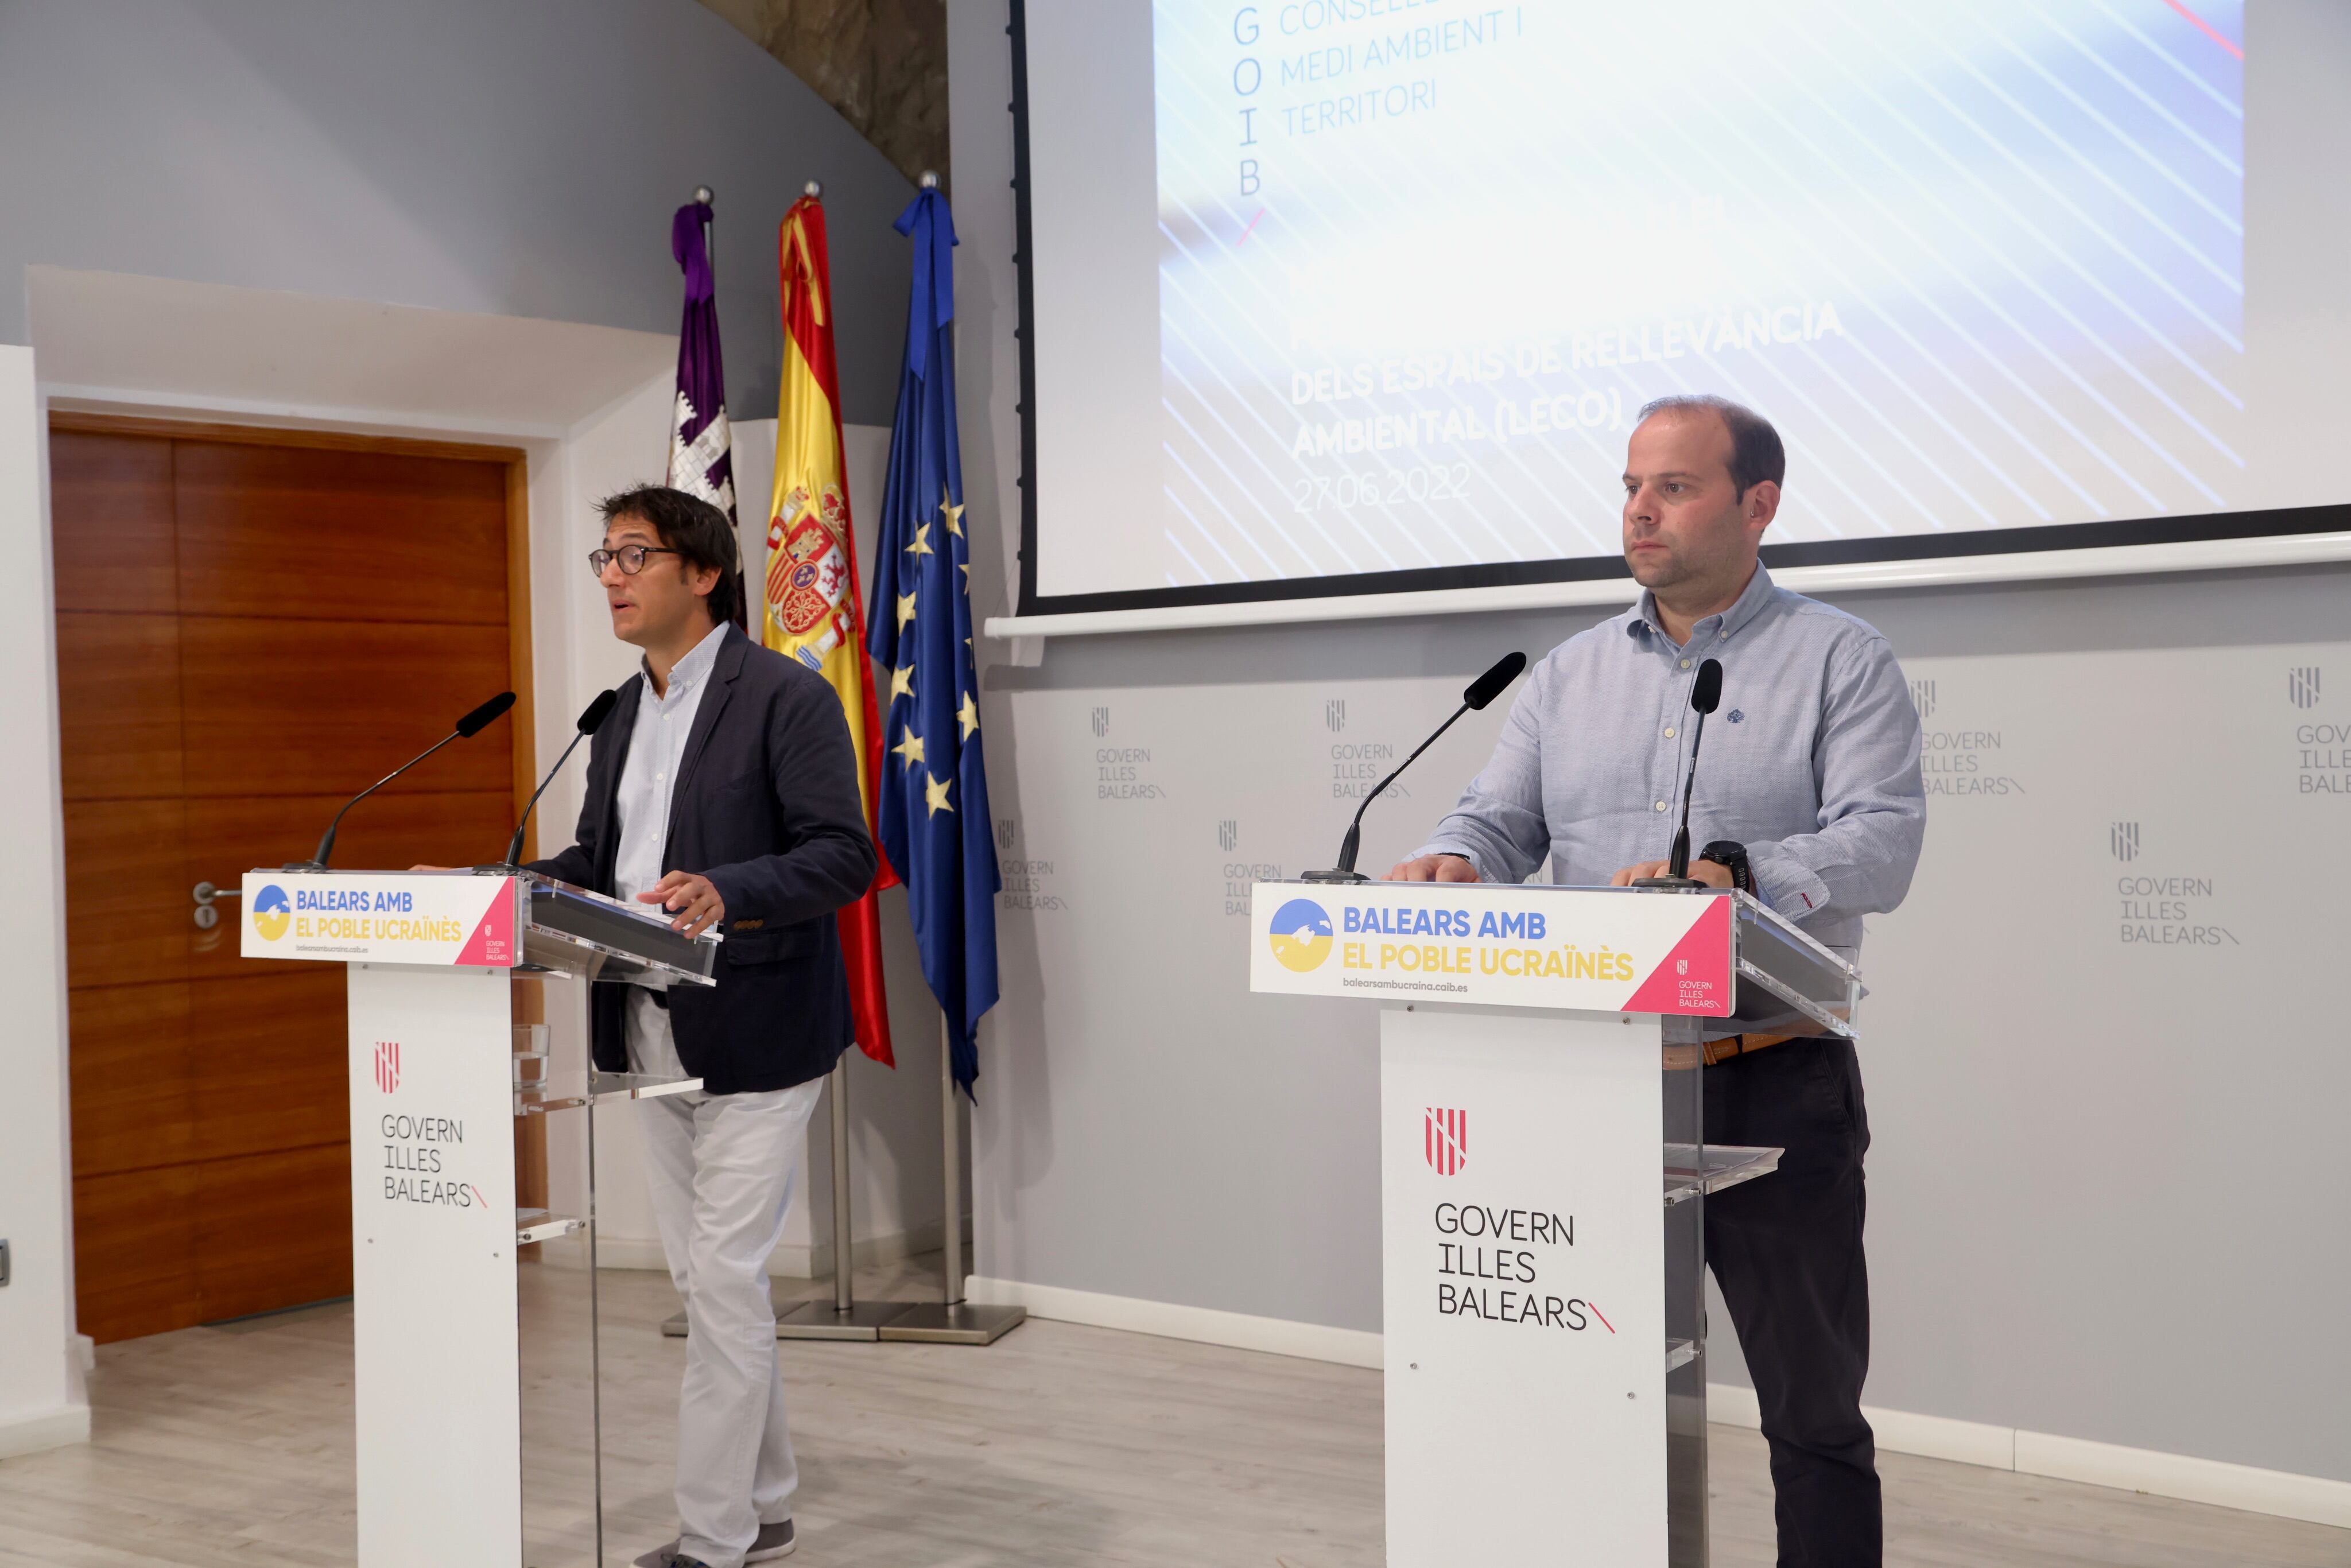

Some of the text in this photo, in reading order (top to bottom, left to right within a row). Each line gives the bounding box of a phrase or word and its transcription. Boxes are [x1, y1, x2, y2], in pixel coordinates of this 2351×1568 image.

[1280, 0, 1440, 35] CONSE
[1281, 6, 1522, 87] MEDI AMBIENT I
[1281, 78, 1436, 137] TERRITORI
[1291, 363, 1374, 405] DELS
[1383, 346, 1506, 395] ESPAIS
[1516, 337, 1561, 379] DE
[1293, 386, 1620, 459] AMBIENTAL (LECO)
[1096, 748, 1151, 763] GOVERN
[1331, 744, 1393, 760] GOVERN
[1098, 766, 1136, 781] ILLES
[1333, 763, 1376, 779] ILLES
[1921, 754, 1978, 773] ILLES
[1098, 784, 1156, 799] BALEARS
[1002, 860, 1054, 875] GOVERN
[1223, 863, 1282, 879] GOVERN
[1004, 878, 1040, 892] ILLES
[2118, 876, 2212, 896] GOVERN
[296, 890, 413, 913] BALEARS AMB
[1003, 895, 1059, 910] BALEARS
[2121, 900, 2187, 920] ILLES
[295, 915, 462, 942] EL POBLE UCRAÏNÈS
[1344, 906, 1546, 940] BALEARS AMB
[2121, 924, 2221, 945] BALEARS
[1343, 942, 1634, 981] EL POBLE UCRAÏNÈS
[1343, 977, 1468, 992] balearsambucraina.caib.es
[1678, 980, 1712, 989] GOVERN
[1679, 989, 1703, 999] ILLES
[1679, 999, 1714, 1008] BALEARS
[381, 1114, 463, 1144] GOVERN
[383, 1145, 441, 1173] ILLES
[384, 1176, 471, 1208] BALEARS
[1435, 1202, 1573, 1246] GOVERN
[1438, 1243, 1535, 1283] ILLES
[1439, 1283, 1586, 1330] BALEARS
